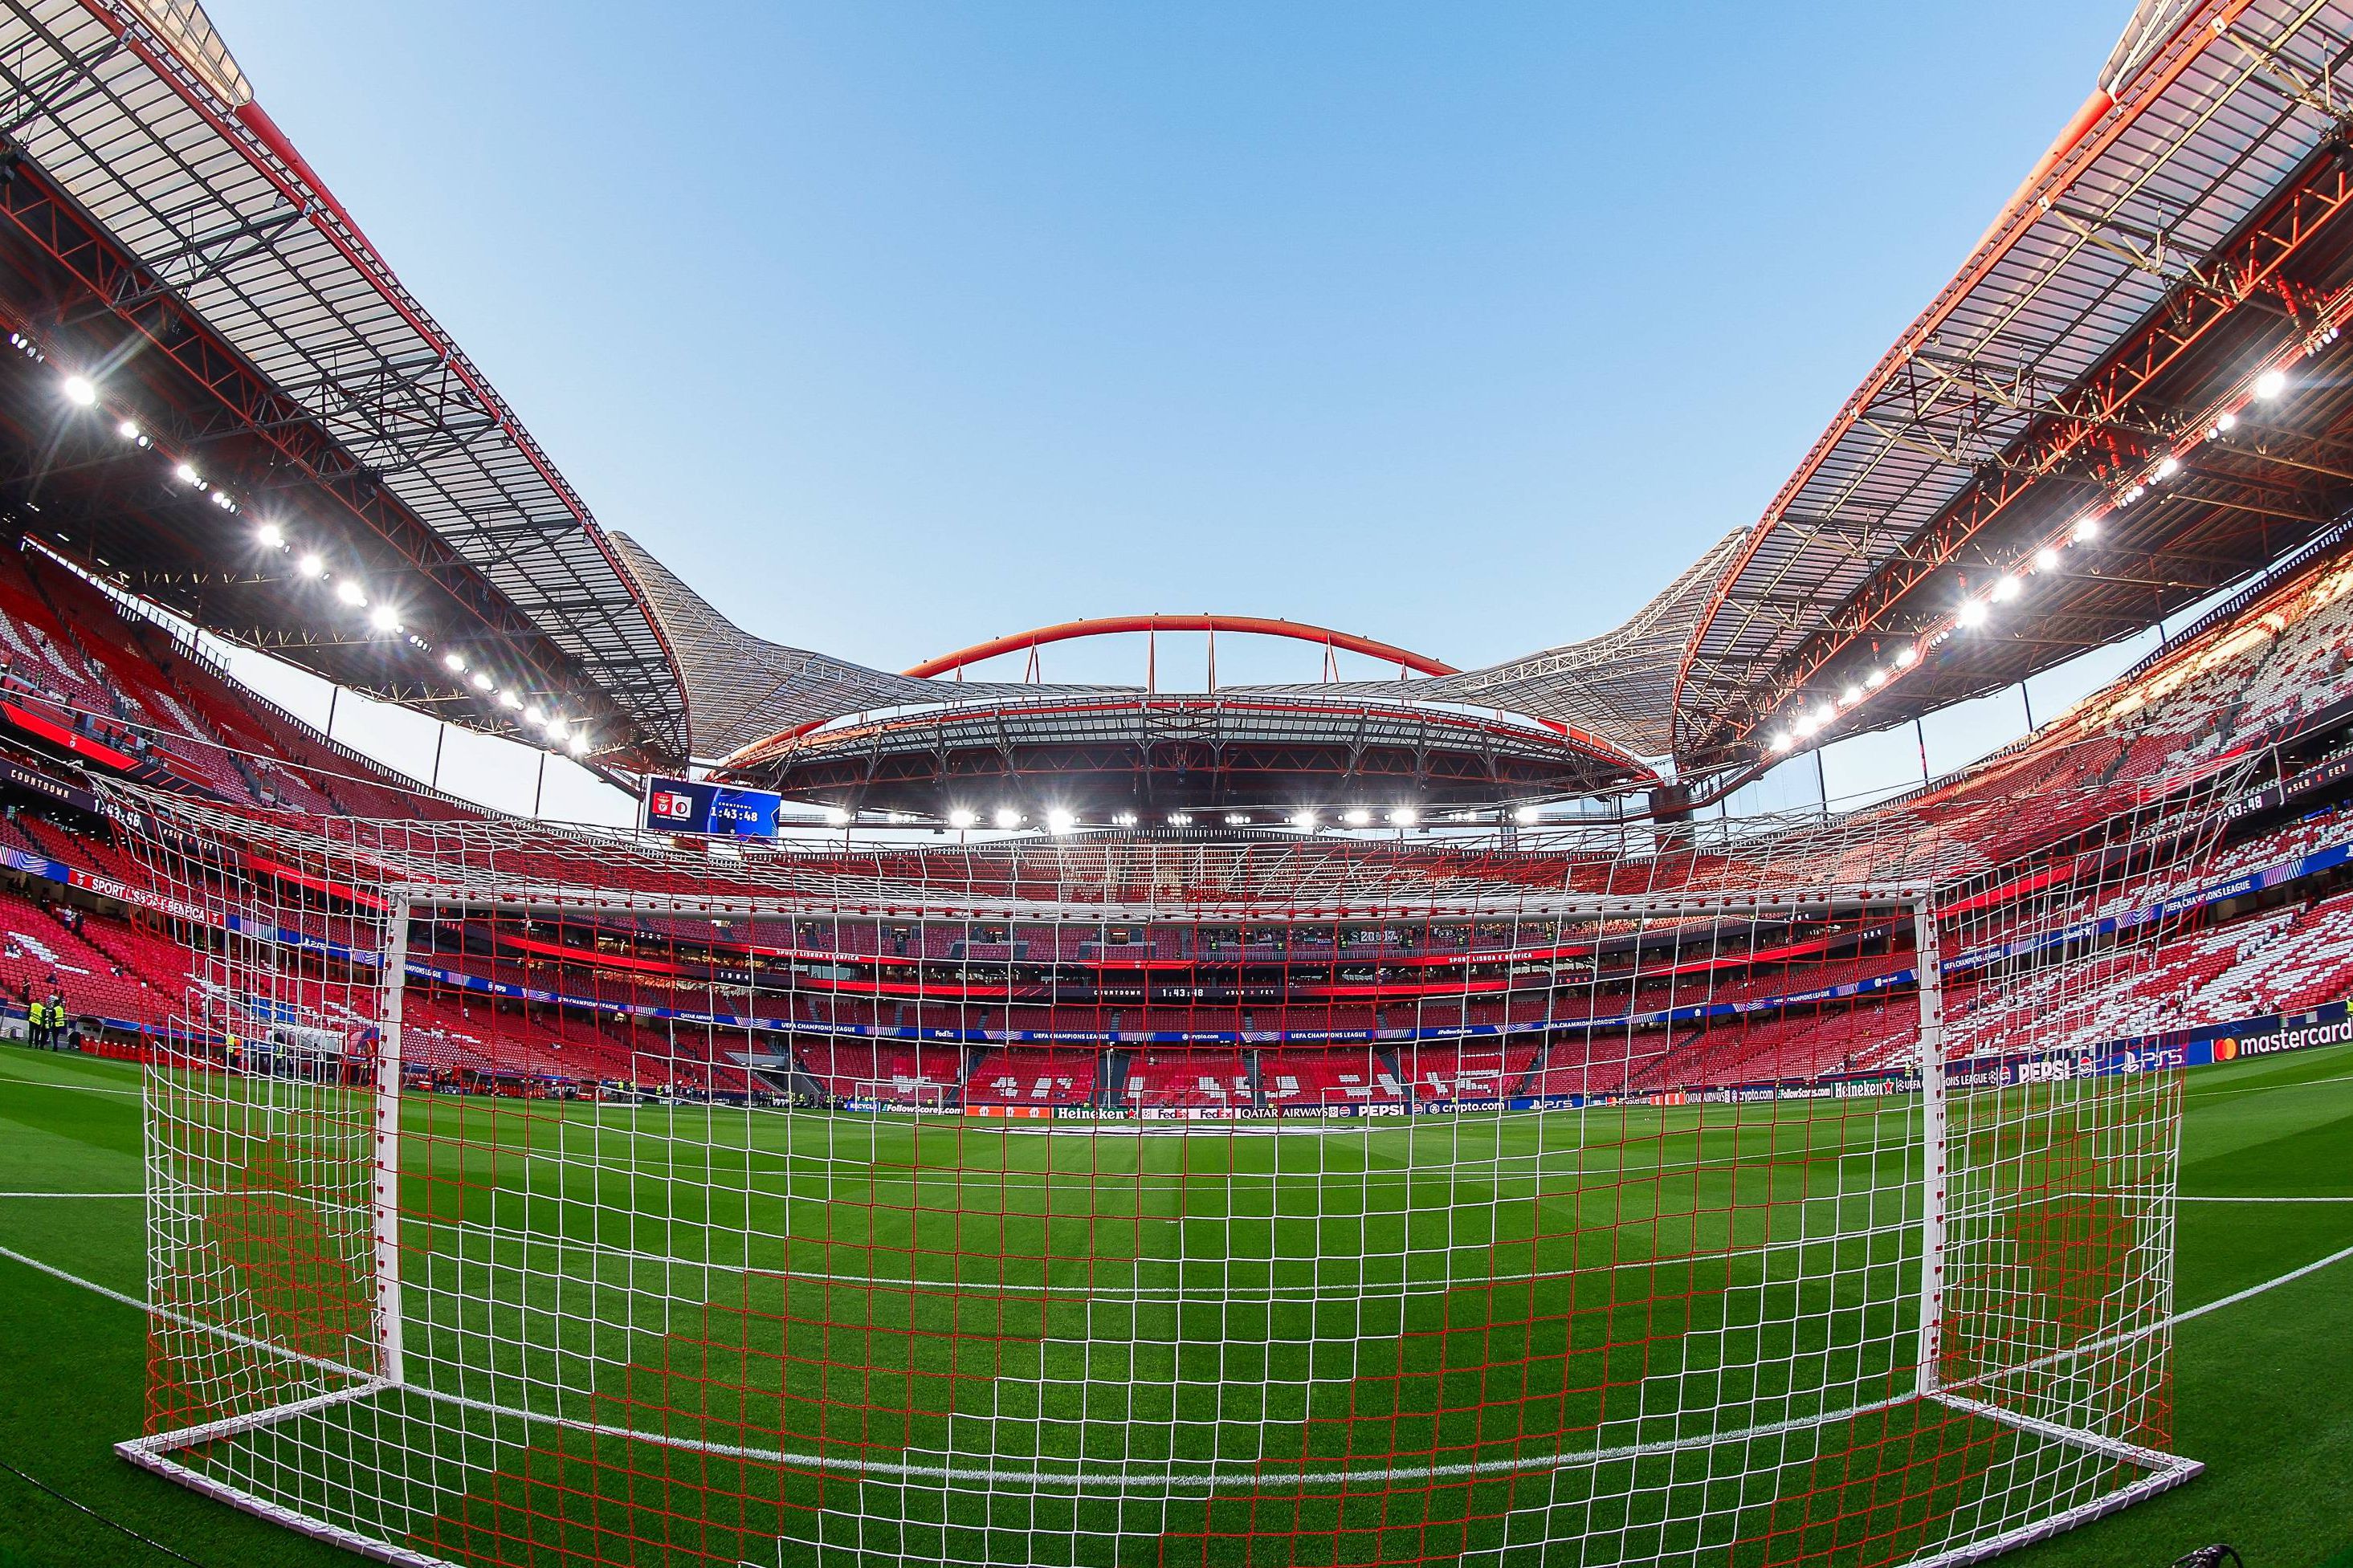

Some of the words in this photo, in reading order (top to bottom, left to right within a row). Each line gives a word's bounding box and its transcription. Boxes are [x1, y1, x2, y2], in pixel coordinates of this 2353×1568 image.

[2329, 764, 2346, 777] FEY
[10, 769, 69, 799] COUNTDOWN
[94, 799, 141, 828] 1:43:48
[711, 806, 758, 822] 1:43:48
[92, 878, 125, 898] SPORT
[168, 899, 205, 922] BENFICA
[2165, 901, 2183, 912] UEFA
[2183, 889, 2223, 907] CHAMPIONS
[2223, 880, 2251, 895] LEAGUE
[1505, 952, 1532, 960] BENFICA
[1955, 955, 1982, 967] CHAMPIONS
[1982, 950, 2001, 961] LEAGUE
[1162, 988, 1204, 997] 1:43:48
[1787, 993, 1813, 1002] CHAMPIONS
[1813, 990, 1830, 999] LEAGUE
[797, 1023, 832, 1031] CHAMPIONS
[833, 1024, 855, 1032] LEAGUE
[2241, 1016, 2352, 1056] mastercard
[2142, 1049, 2185, 1067] PS5
[2018, 1059, 2070, 1083] PEPSI
[1904, 1079, 1921, 1089] UEFA
[1961, 1073, 1988, 1085] LEAGUE
[1835, 1080, 1883, 1098] Heineken
[1686, 1093, 1702, 1104] QATAR
[1703, 1091, 1724, 1103] AIRWAYS
[887, 1105, 963, 1114] FollowScores.com
[1358, 1104, 1405, 1117] PEPSI
[1442, 1102, 1505, 1114] crypto.com
[1544, 1100, 1572, 1109] PS5
[1058, 1107, 1124, 1119] Heineken
[1158, 1109, 1189, 1119] FedEx
[1201, 1109, 1231, 1118] FedEx
[1242, 1108, 1278, 1118] QATAR
[1283, 1107, 1328, 1118] AIRWAYS
